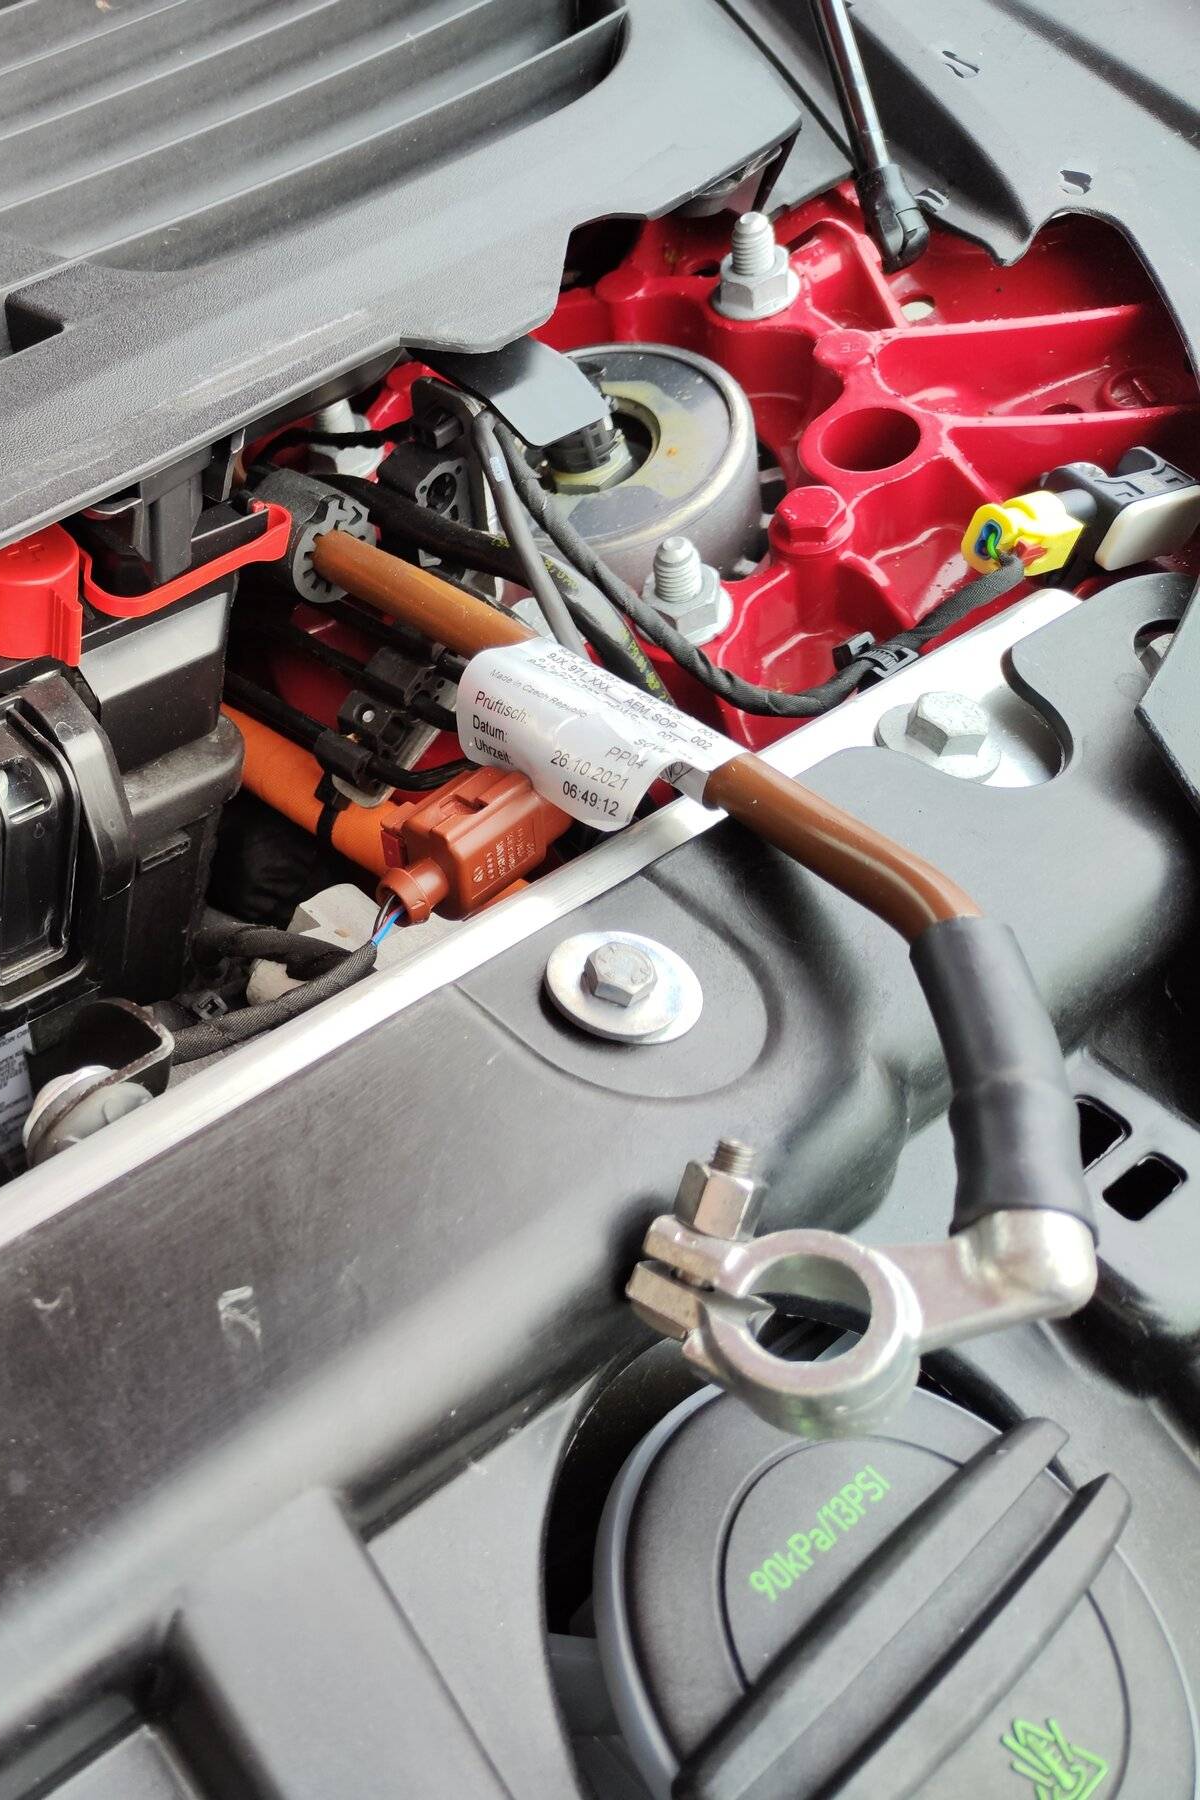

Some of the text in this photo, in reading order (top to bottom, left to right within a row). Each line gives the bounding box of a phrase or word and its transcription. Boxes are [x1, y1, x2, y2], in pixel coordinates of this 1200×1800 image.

[472, 714, 508, 743] Datum:
[474, 737, 514, 766] Uhrzeit:
[605, 746, 649, 769] PP04
[550, 750, 629, 790] 26.10.2021
[562, 780, 620, 817] 06:49:12
[749, 1465, 892, 1602] 90kPa/13PSI
